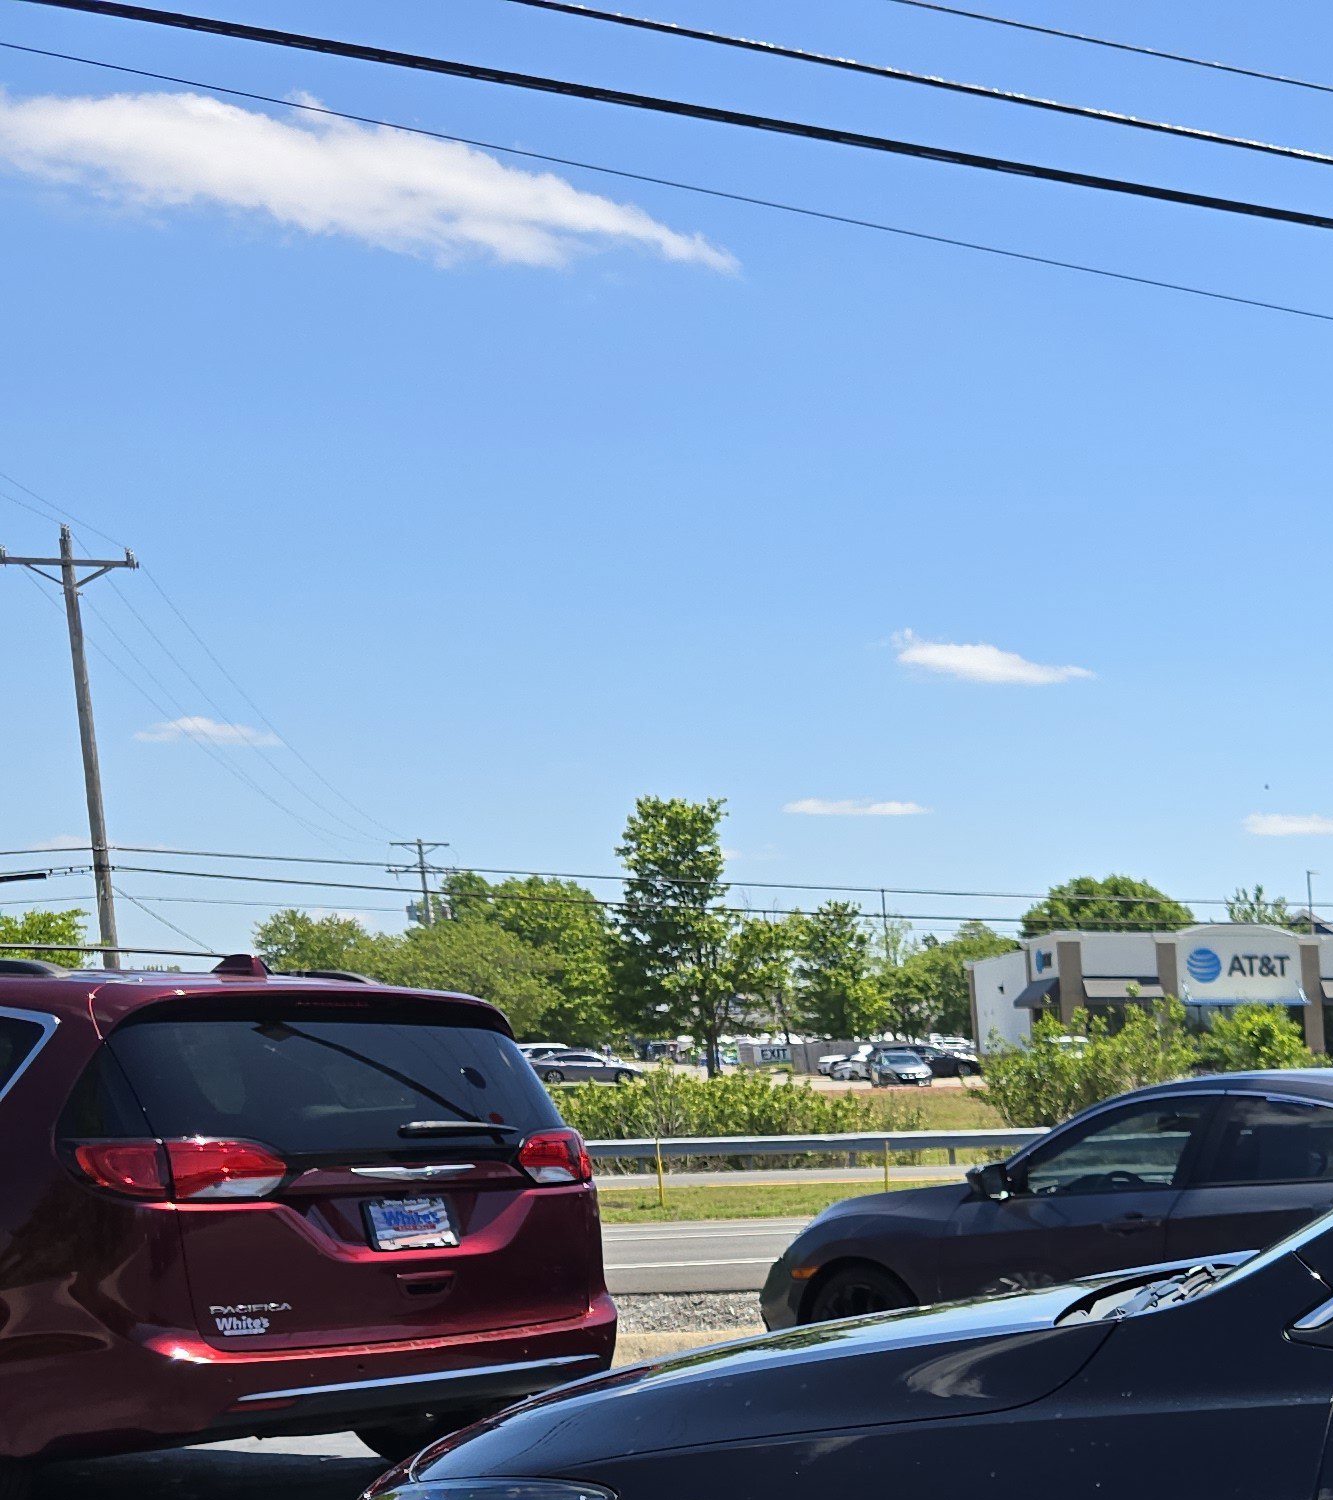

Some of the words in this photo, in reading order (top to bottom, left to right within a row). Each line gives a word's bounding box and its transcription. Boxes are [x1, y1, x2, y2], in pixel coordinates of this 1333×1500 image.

[1227, 953, 1291, 978] AT&T
[760, 1048, 788, 1061] EXIT
[209, 1302, 292, 1315] PACIFICA
[215, 1315, 270, 1331] White's
